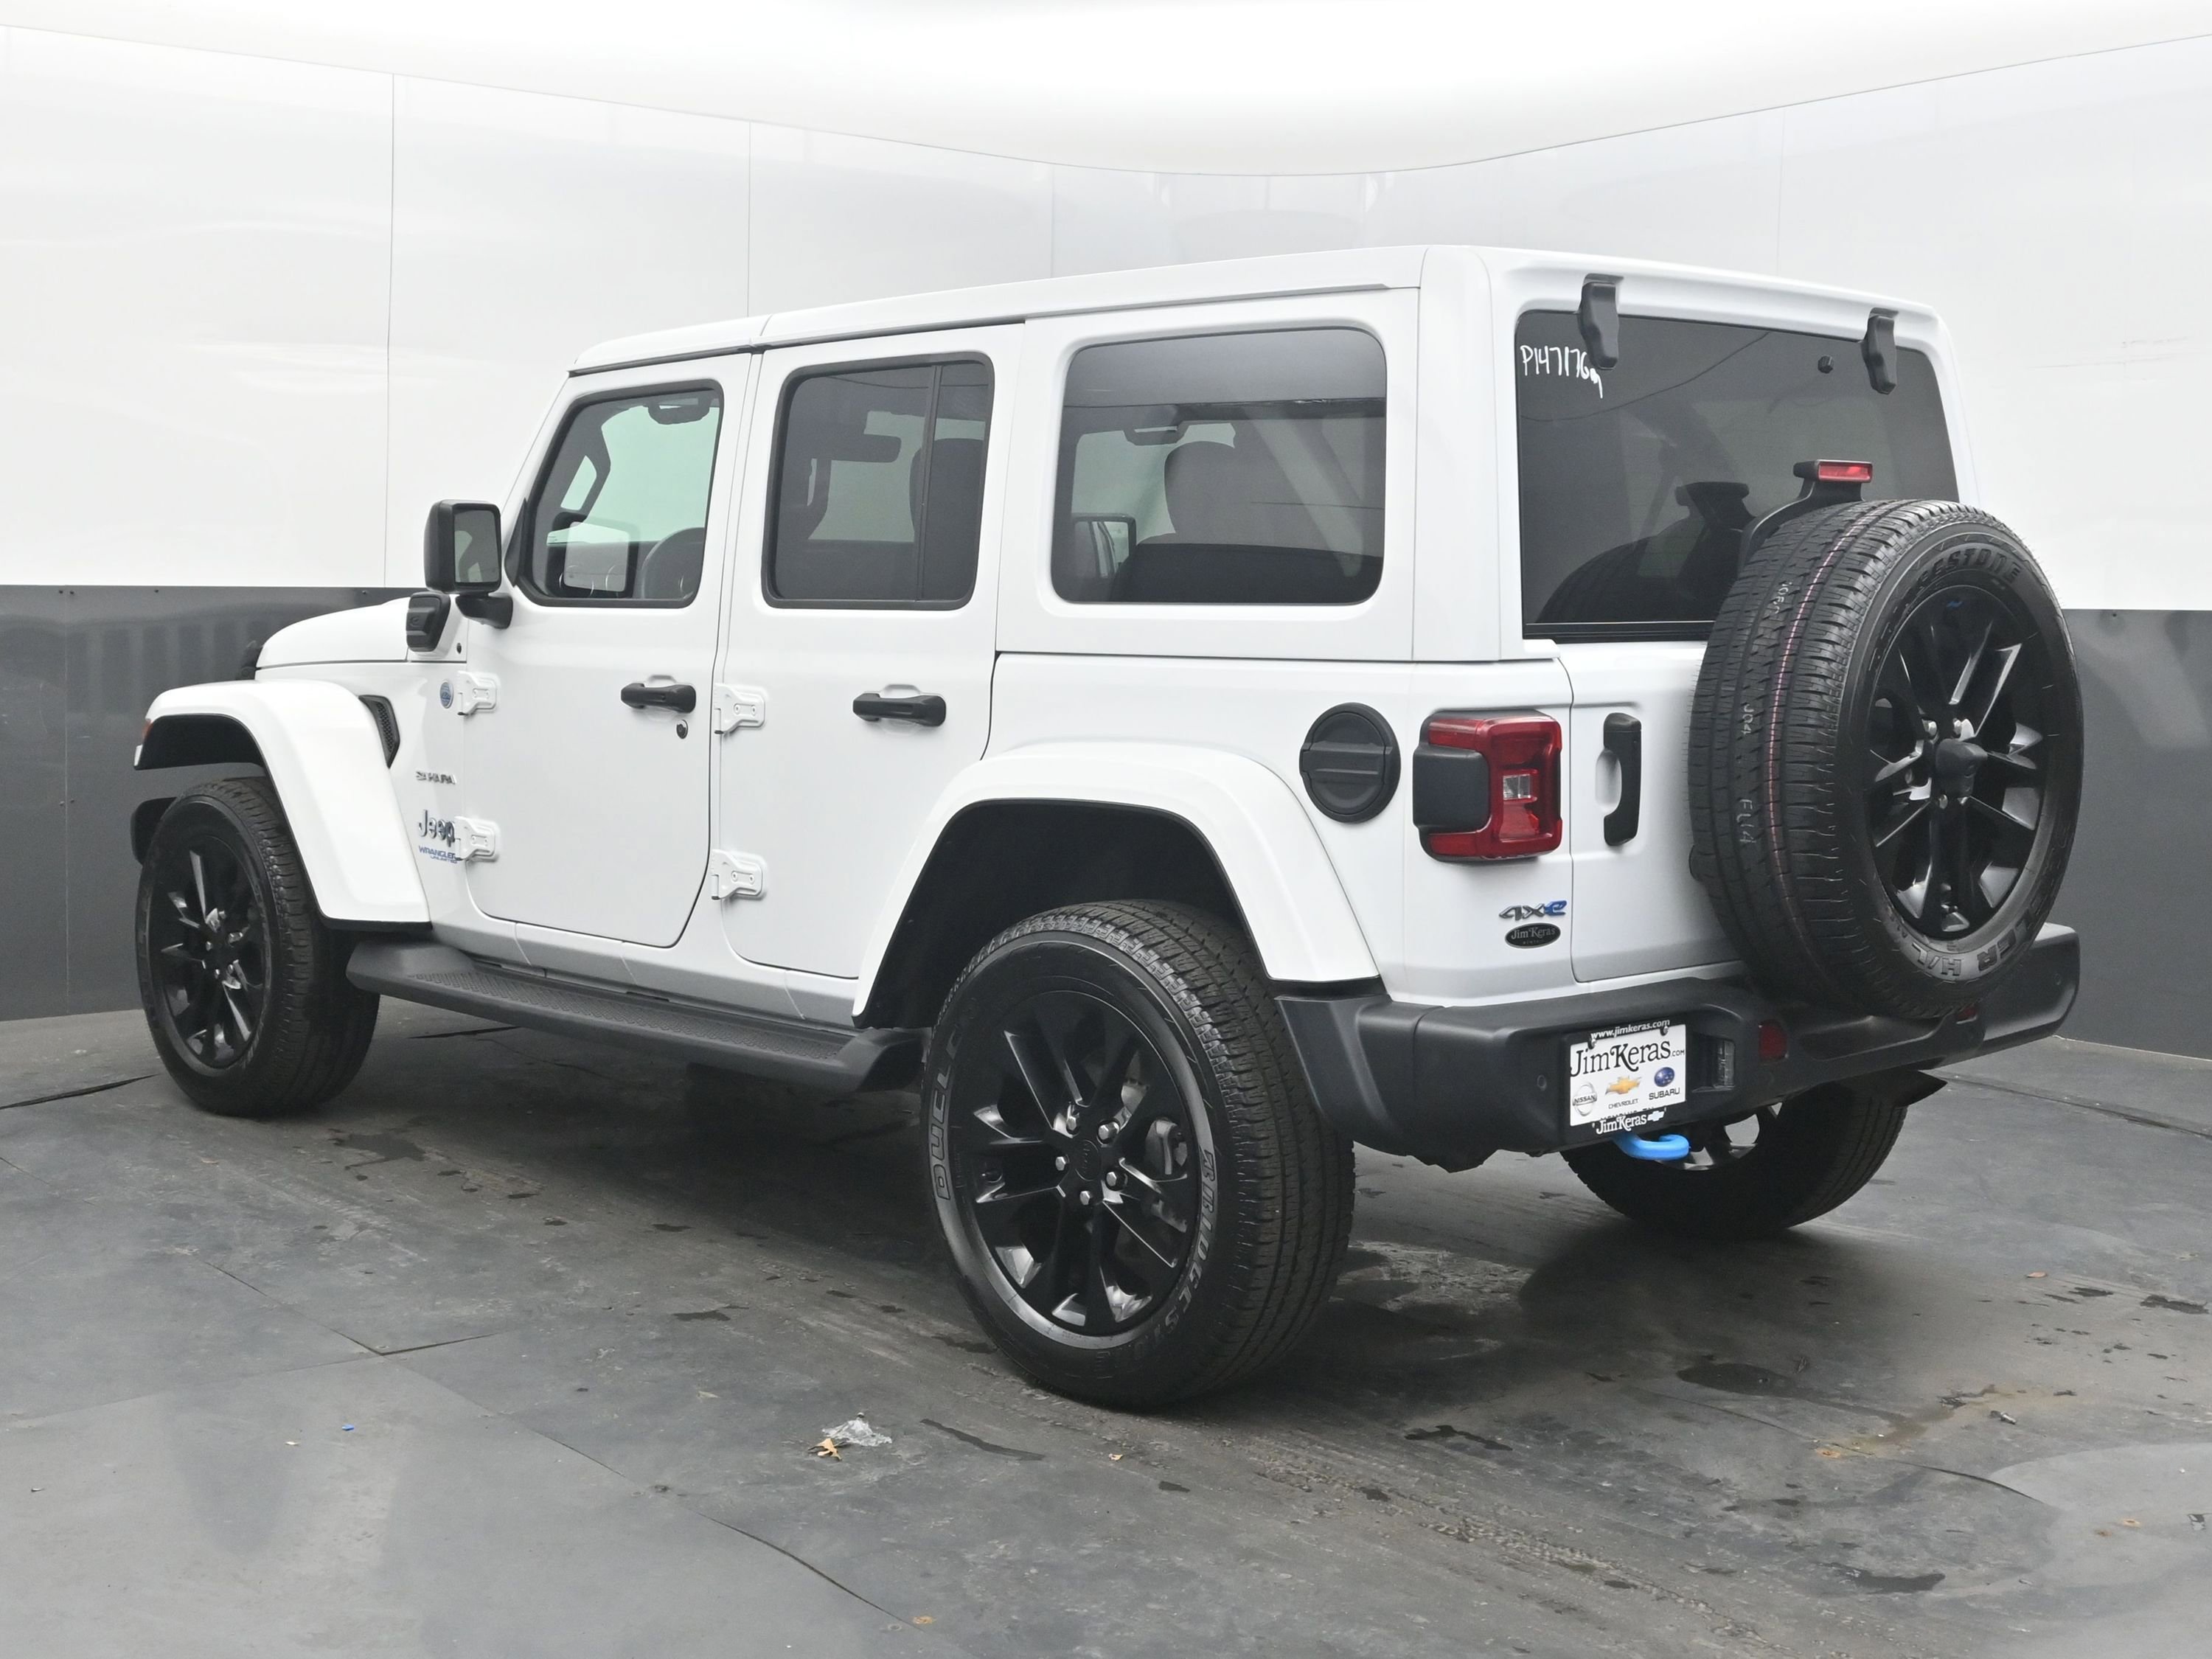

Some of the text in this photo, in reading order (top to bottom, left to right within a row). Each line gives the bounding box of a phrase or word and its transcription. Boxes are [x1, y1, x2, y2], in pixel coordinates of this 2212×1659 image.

[418, 810, 455, 847] Jeep
[1590, 1020, 1671, 1039] www.jimkeras.com
[1573, 1094, 1596, 1105] NISSAN
[1649, 1088, 1680, 1101] SUBARU
[1608, 1099, 1639, 1110] CHEVROLET
